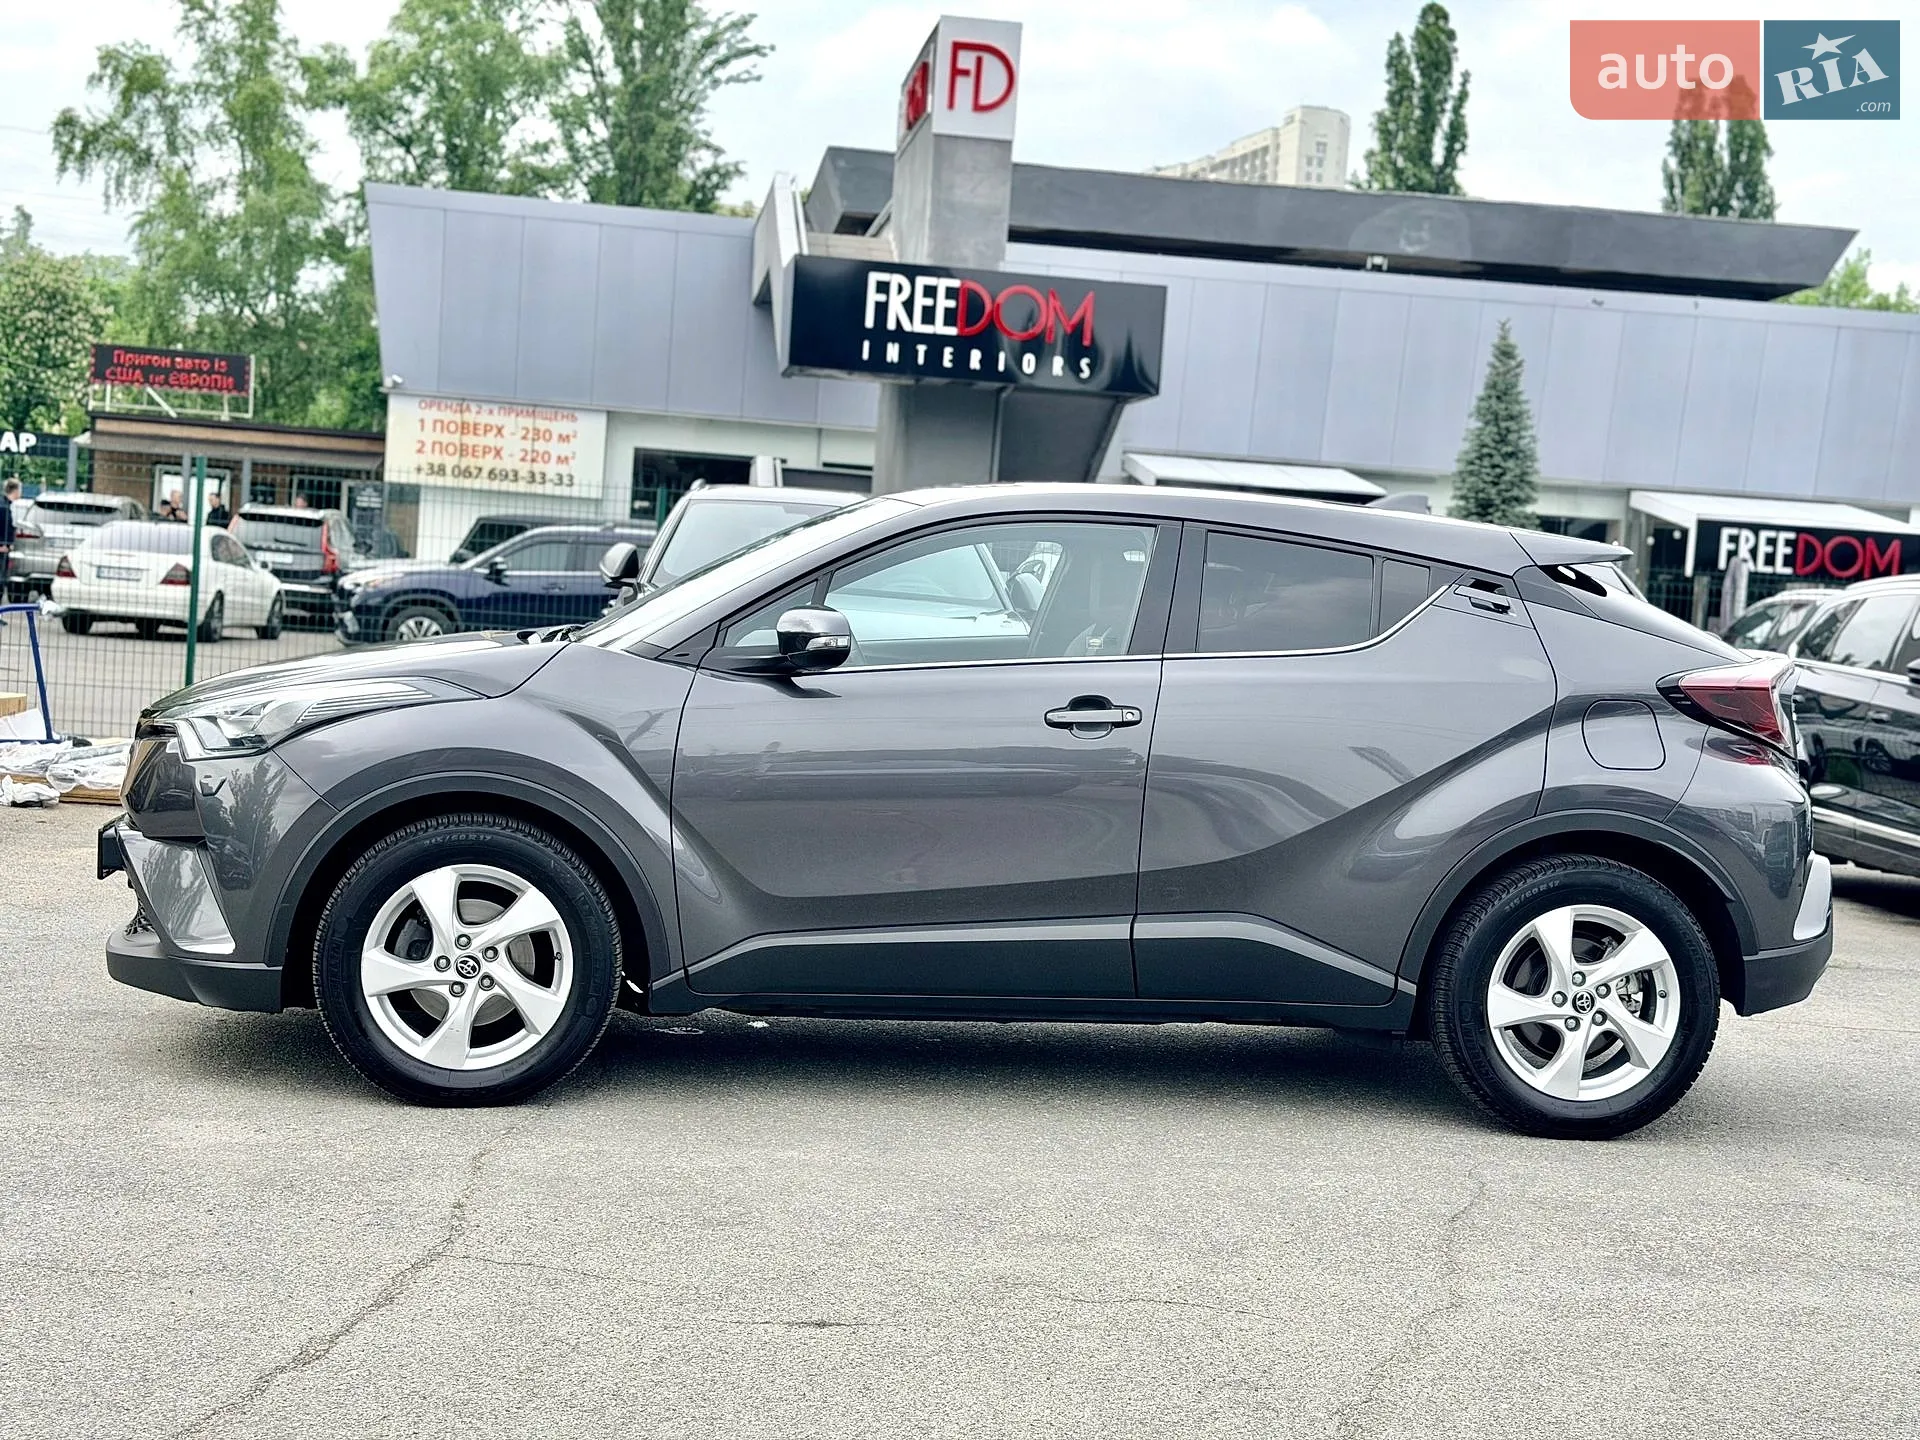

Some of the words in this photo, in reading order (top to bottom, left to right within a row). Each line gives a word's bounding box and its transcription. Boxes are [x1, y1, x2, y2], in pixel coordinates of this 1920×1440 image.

[946, 40, 1015, 113] FD
[864, 270, 1095, 347] FREEDOM
[113, 349, 172, 369] Пригон
[861, 339, 1091, 379] INTERIORS
[105, 367, 144, 383] США
[417, 399, 473, 414] ОРЕНДА
[499, 405, 578, 422] ПРИМІЩЕНЬ
[418, 418, 426, 432] 1
[432, 419, 505, 439] ПОВЕРХ
[520, 427, 553, 444] 230
[416, 439, 426, 456] 2
[431, 441, 504, 461] ПОВЕРХ
[519, 448, 552, 465] 220
[415, 462, 447, 477] +38
[451, 467, 484, 480] 067
[488, 467, 575, 488] 693-33-33
[1717, 526, 1902, 579] FREEDOM
